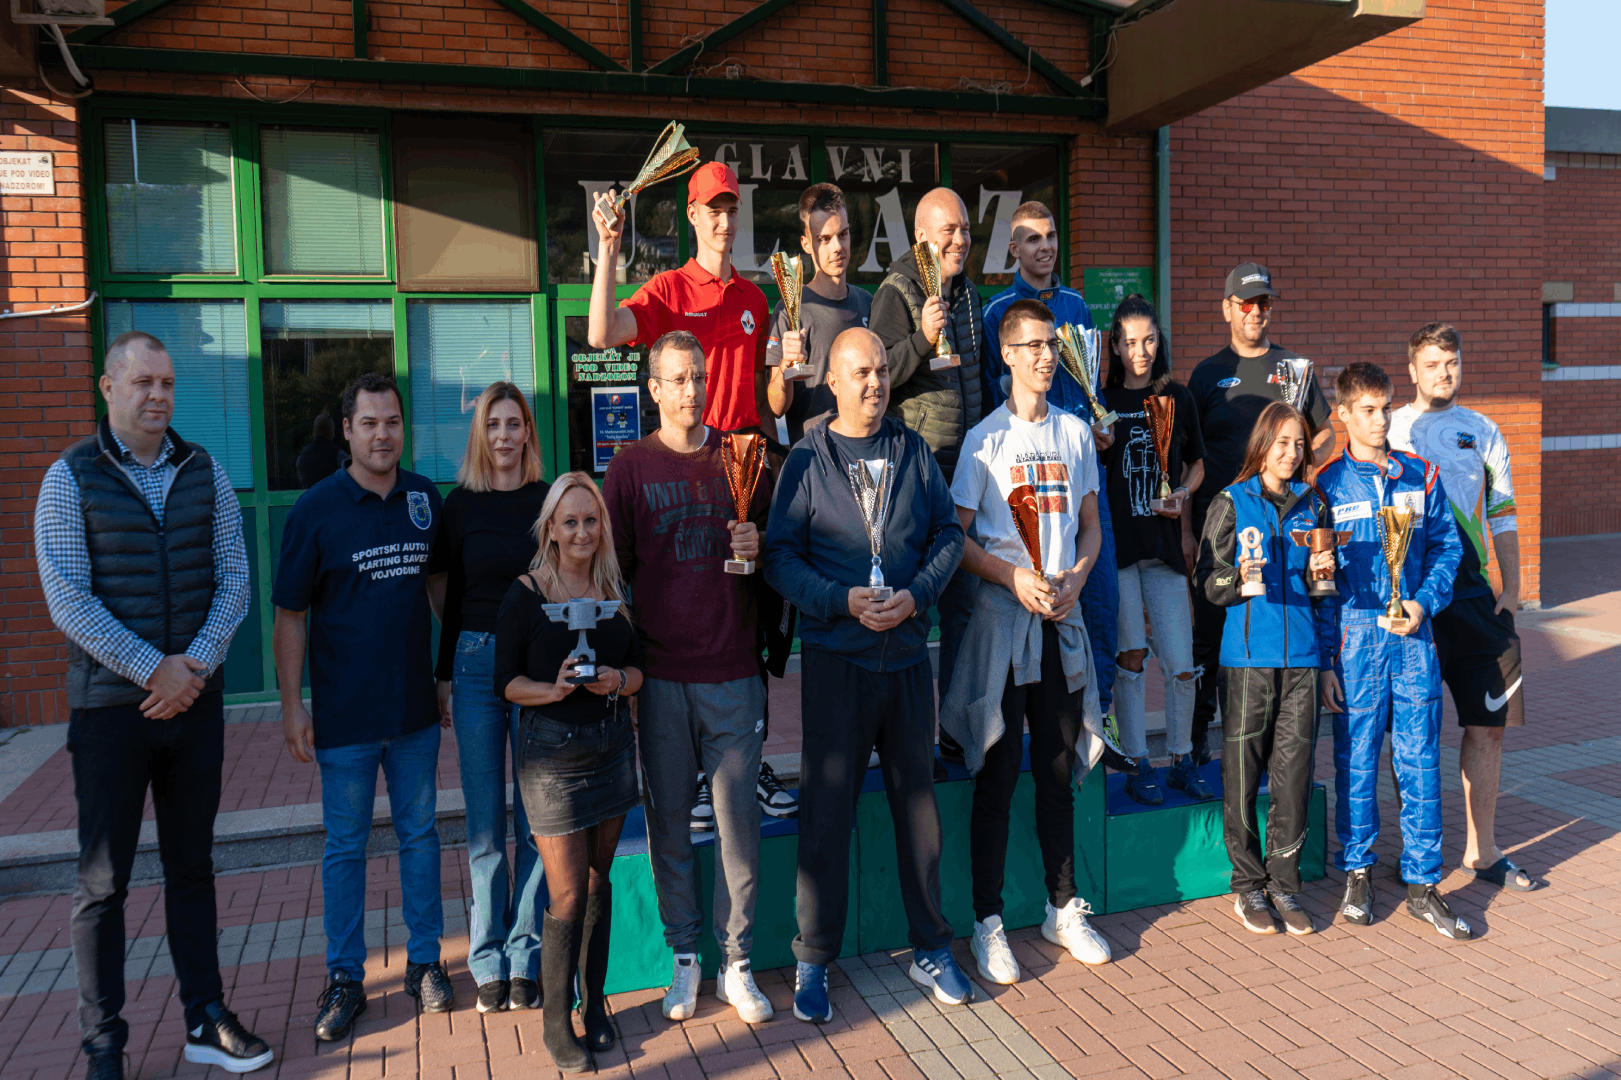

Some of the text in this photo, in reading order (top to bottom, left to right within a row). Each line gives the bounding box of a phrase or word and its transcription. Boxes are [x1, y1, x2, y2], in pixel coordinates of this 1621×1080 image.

[714, 142, 914, 183] GLAVNI
[11, 170, 25, 178] POD
[28, 170, 50, 178] VIDEO
[0, 182, 45, 190] NADZOROM!
[578, 180, 1023, 280] ULAZ
[571, 352, 641, 362] OBJEKAT JE
[575, 363, 638, 372] POD VIDEO
[578, 372, 637, 381] NADZOROM
[643, 480, 691, 512] VNTG
[352, 543, 400, 562] SPORTSKI
[402, 542, 426, 552] AUTO
[674, 529, 727, 562] GOODS
[358, 554, 428, 573] KARTING SAVEZ
[371, 565, 420, 580] VOJVODINE
